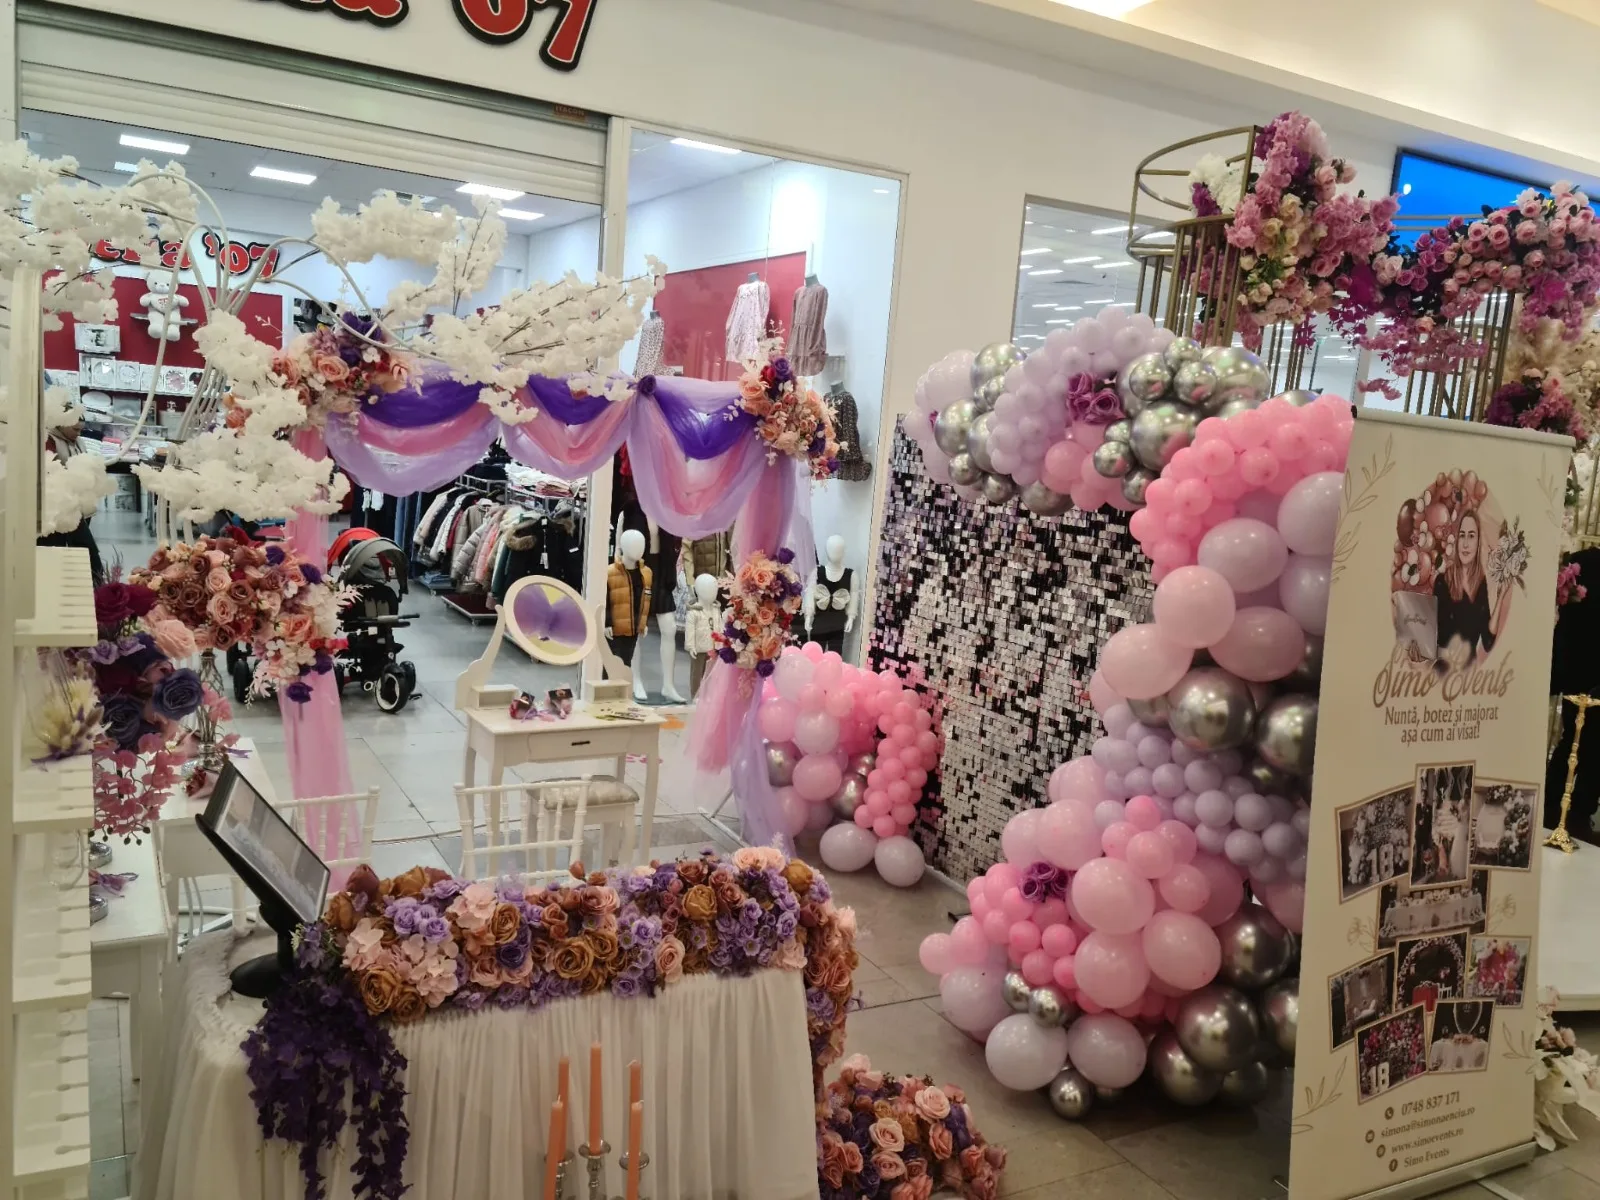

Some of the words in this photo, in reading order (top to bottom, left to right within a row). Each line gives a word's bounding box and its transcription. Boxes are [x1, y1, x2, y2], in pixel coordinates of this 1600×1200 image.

[1373, 643, 1438, 708] Simo
[1441, 650, 1515, 706] Events
[1384, 706, 1420, 727] Nuntă,
[1423, 705, 1453, 724] botez
[1464, 703, 1499, 725] majorat
[1420, 728, 1444, 742] cum
[1446, 724, 1456, 742] ai
[1457, 723, 1481, 741] visat!
[1366, 843, 1395, 884] 18
[1367, 1061, 1390, 1096] 18
[1401, 1100, 1424, 1116] 0748
[1426, 1096, 1444, 1110] 837
[1445, 1091, 1460, 1105] 171
[1404, 1155, 1425, 1168] Simo
[1425, 1148, 1450, 1161] Events
